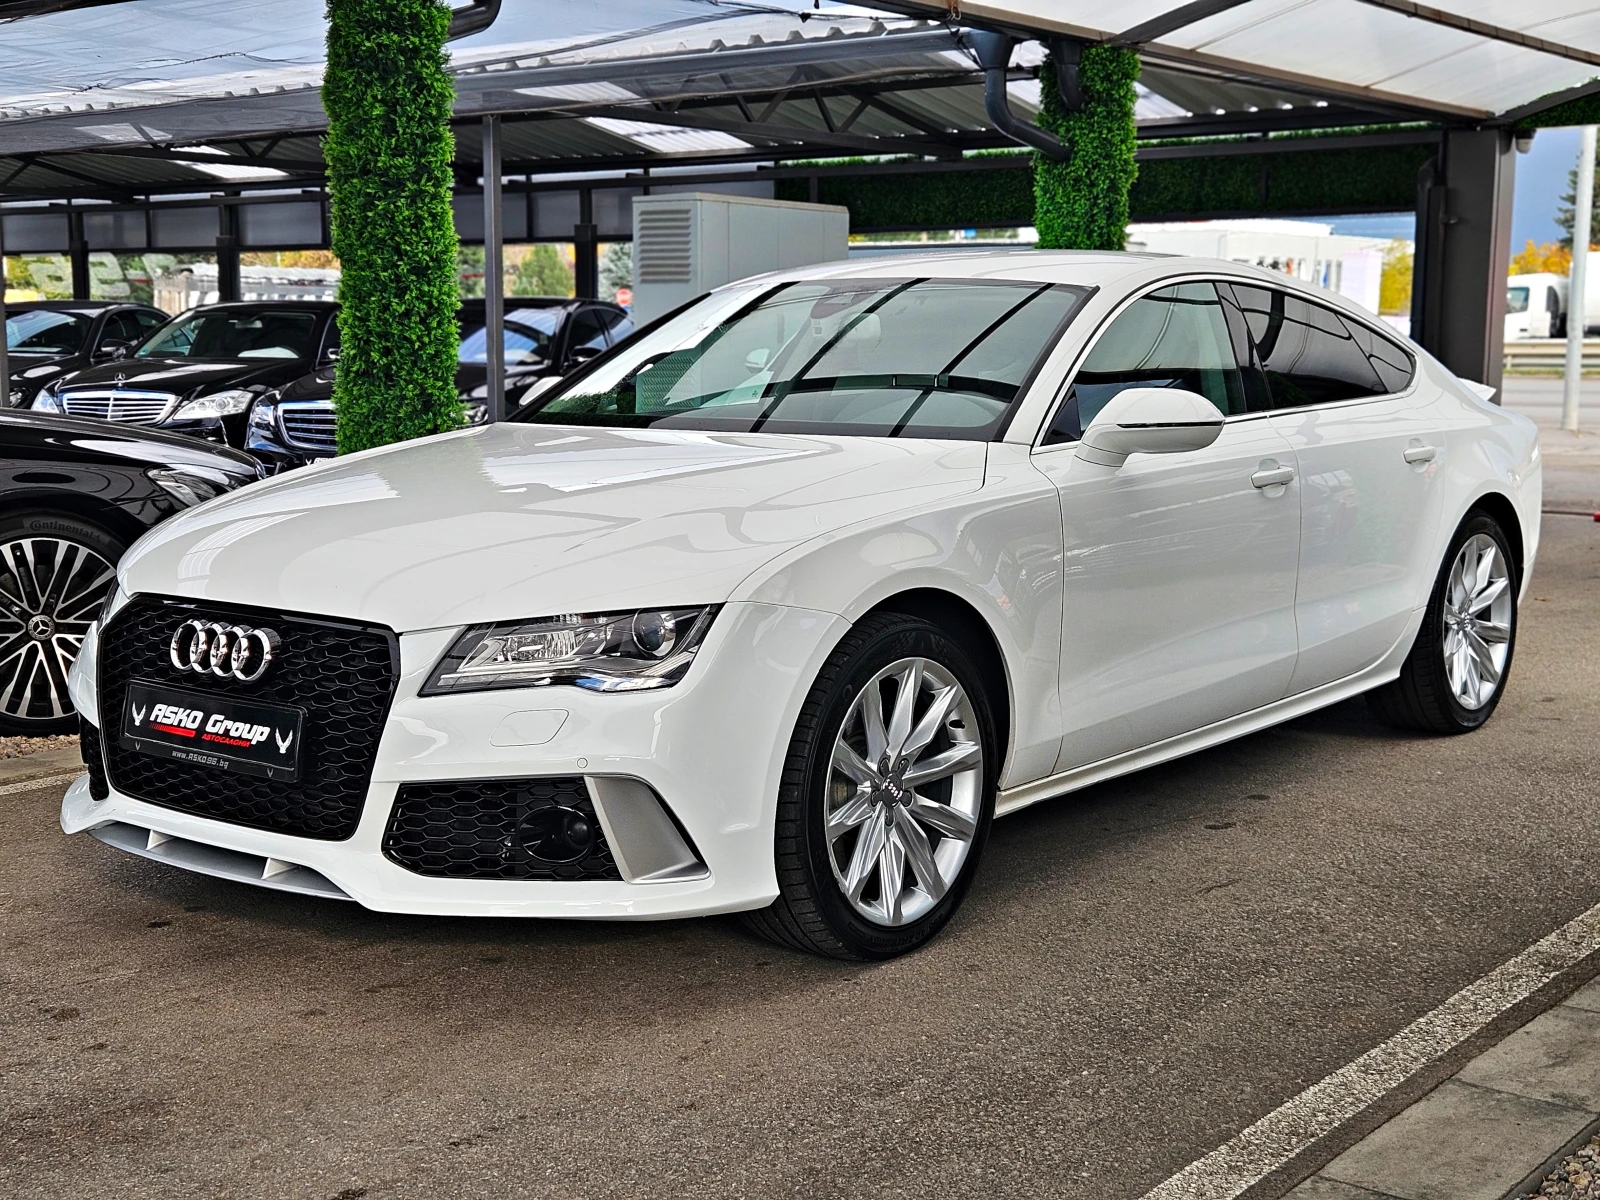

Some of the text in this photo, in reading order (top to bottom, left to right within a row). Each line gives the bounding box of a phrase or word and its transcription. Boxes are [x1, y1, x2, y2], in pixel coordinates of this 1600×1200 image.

[31, 520, 94, 538] Continental
[150, 704, 271, 745] ASKO Group
